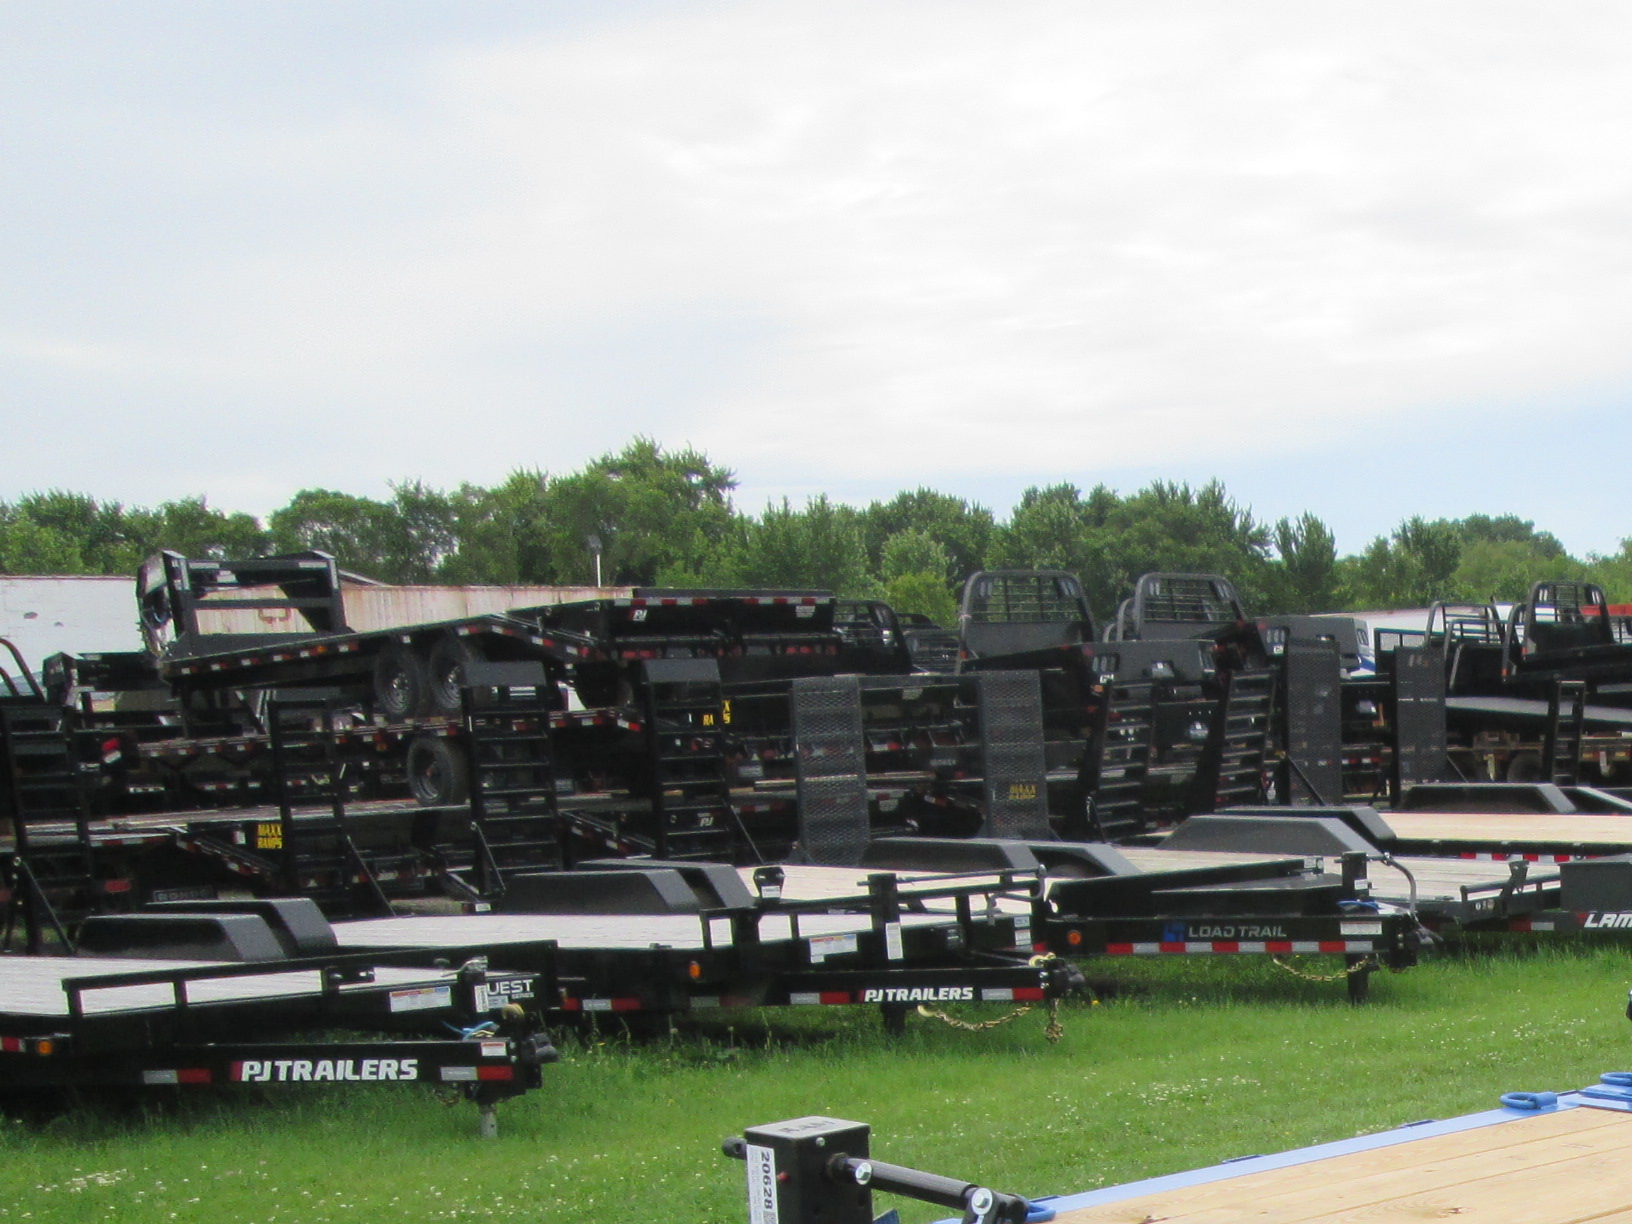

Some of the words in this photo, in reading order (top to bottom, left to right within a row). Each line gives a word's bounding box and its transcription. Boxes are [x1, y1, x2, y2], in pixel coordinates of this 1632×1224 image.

[257, 824, 282, 835] MAXX
[257, 837, 282, 849] RAMPS
[1188, 926, 1235, 938] LOAD
[1238, 925, 1287, 938] TRAIL
[487, 979, 533, 995] UEST
[864, 989, 883, 1002] PJ
[886, 987, 974, 1001] TRAILERS
[241, 1060, 272, 1082] PJ
[274, 1059, 418, 1081] TRAILERS
[761, 1151, 773, 1210] 20628
